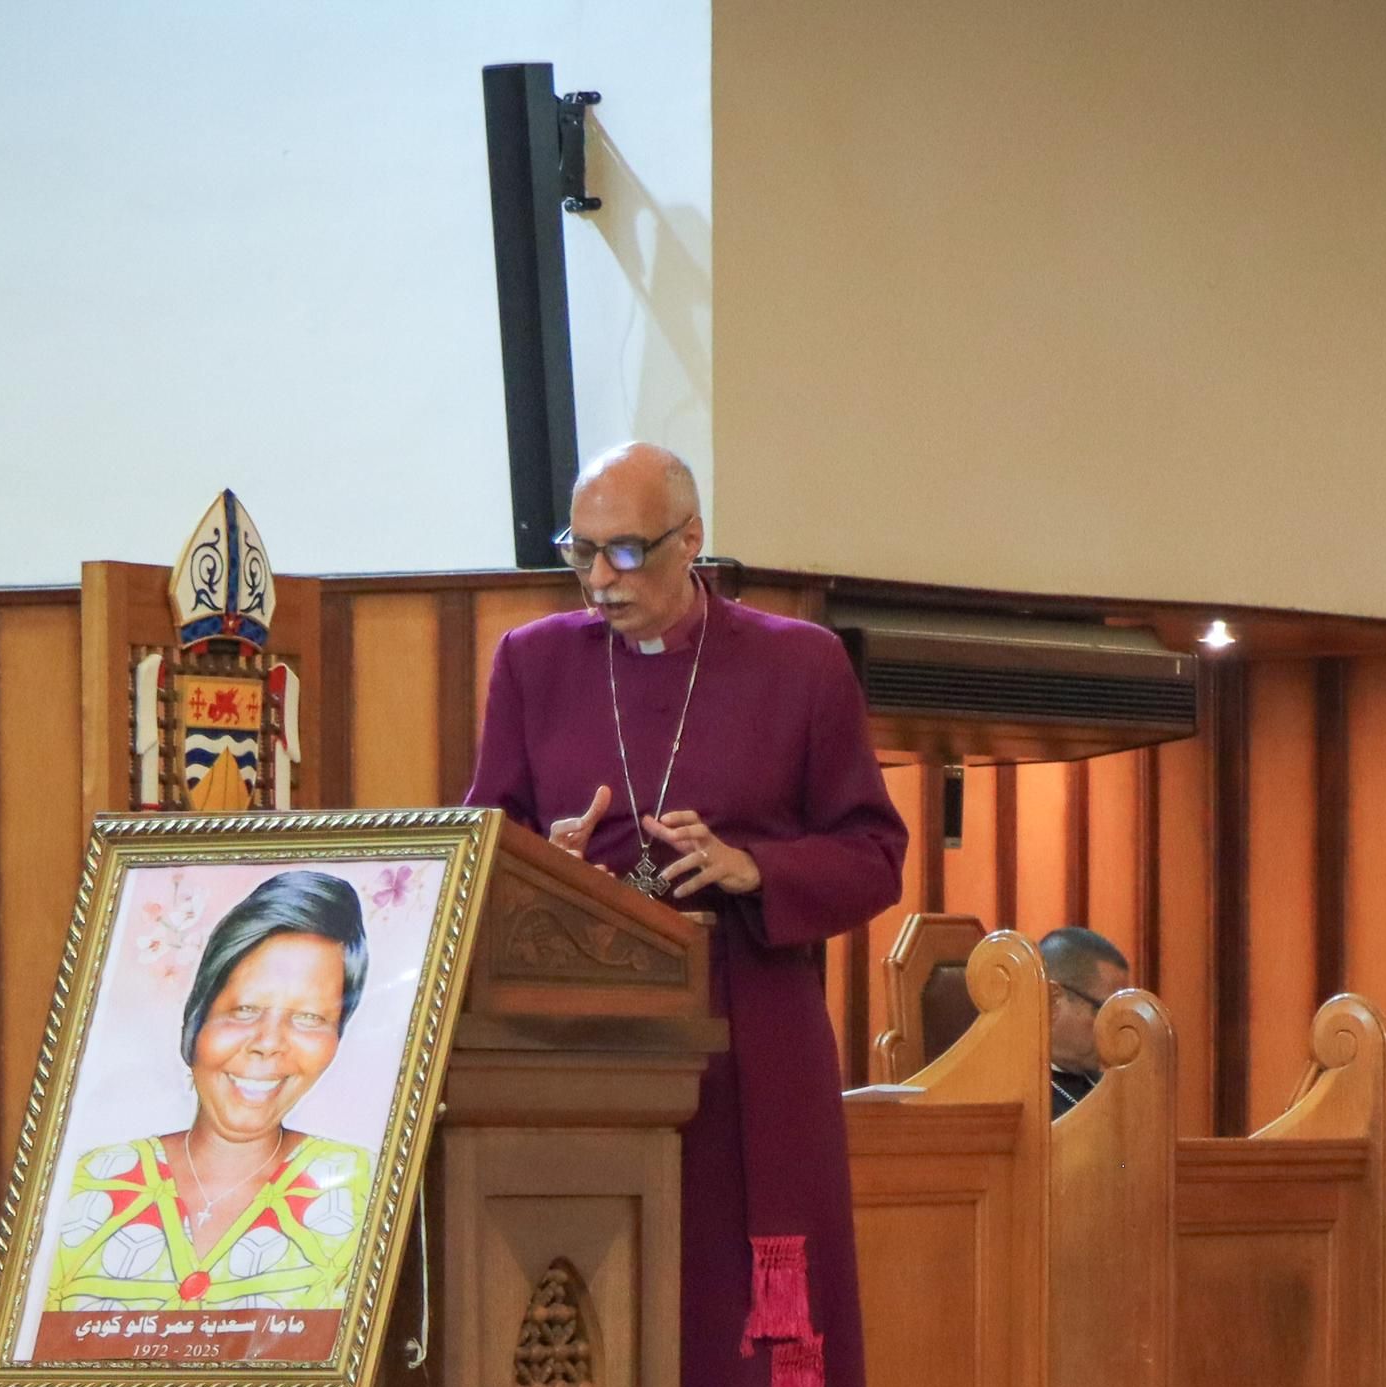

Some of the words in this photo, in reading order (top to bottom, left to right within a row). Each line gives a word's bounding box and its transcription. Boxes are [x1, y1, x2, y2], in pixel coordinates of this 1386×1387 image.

[124, 1314, 159, 1338] كالو
[159, 1320, 195, 1338] عمر
[199, 1315, 257, 1338] سعدية
[133, 1343, 169, 1358] 1972
[184, 1343, 220, 1358] 2025
